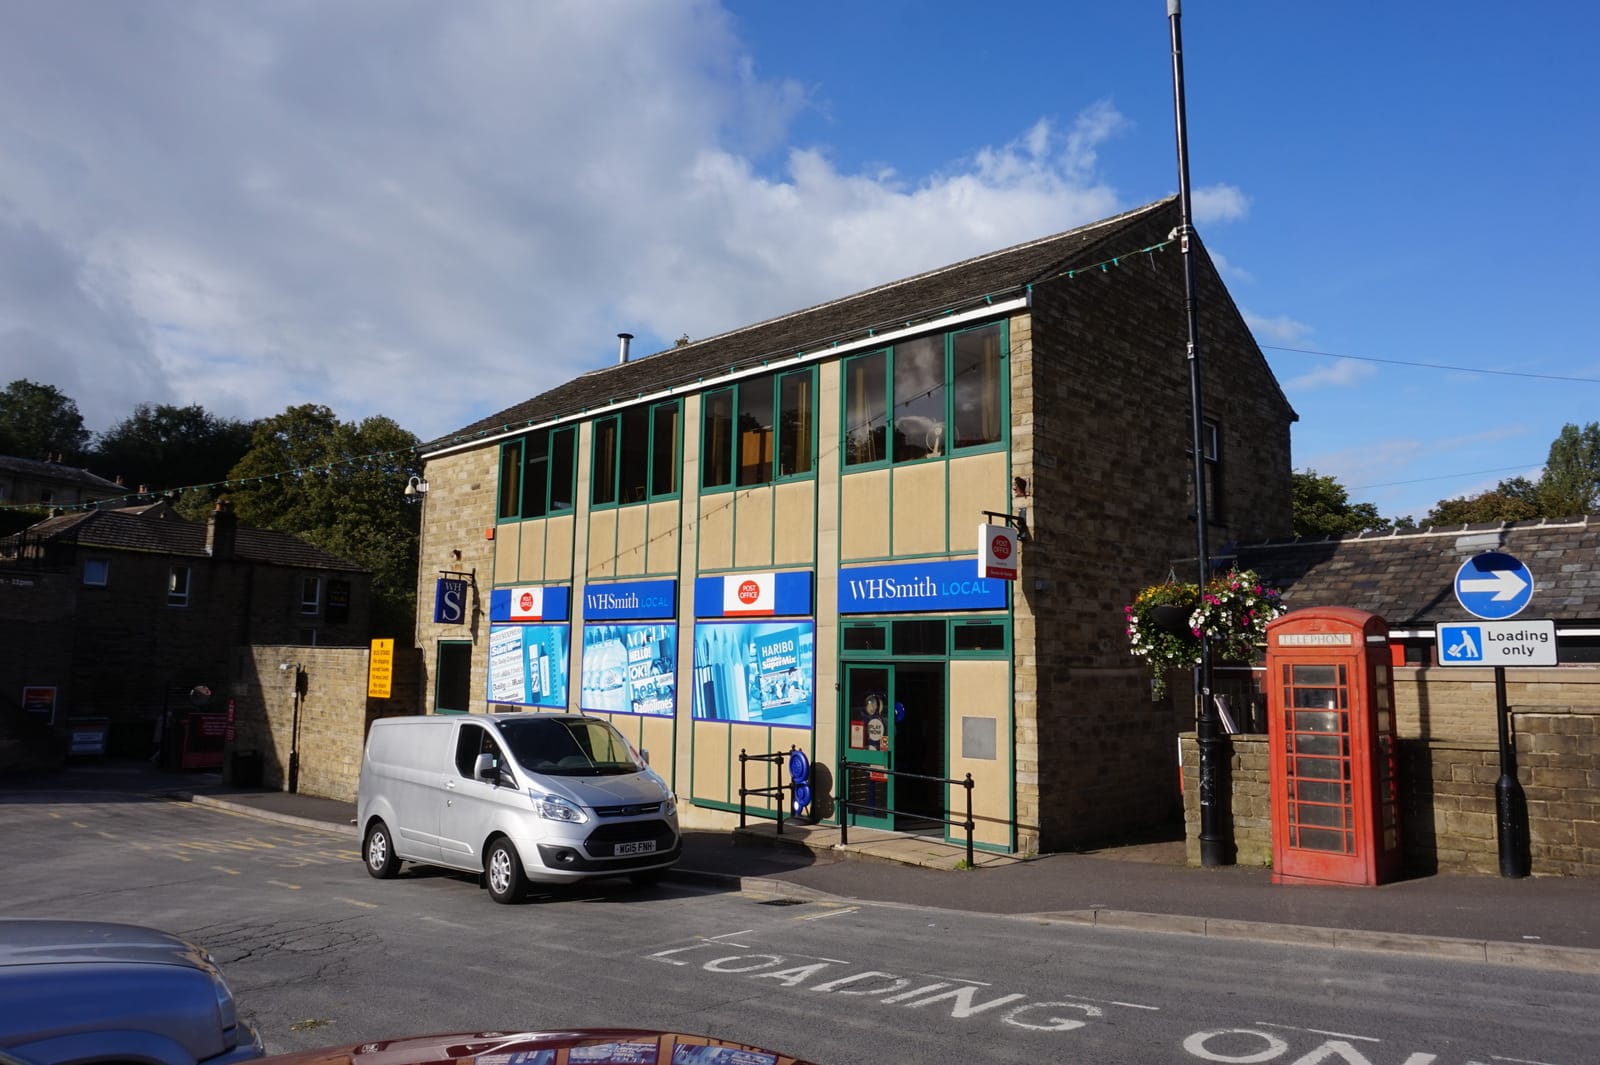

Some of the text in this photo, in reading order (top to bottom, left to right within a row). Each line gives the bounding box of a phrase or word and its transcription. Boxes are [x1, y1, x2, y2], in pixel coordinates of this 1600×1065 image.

[445, 582, 461, 591] WH
[849, 576, 990, 600] WHSmith LOCAL
[442, 591, 461, 621] S
[588, 592, 669, 610] WHSmith LOCAL
[1282, 634, 1349, 645] TELEPHONE
[1488, 630, 1548, 643] Loading
[761, 640, 794, 657] HARIBO
[1502, 644, 1535, 657] only
[631, 664, 648, 680] OK!
[632, 677, 659, 699] heat
[641, 941, 1104, 1032] LOADING
